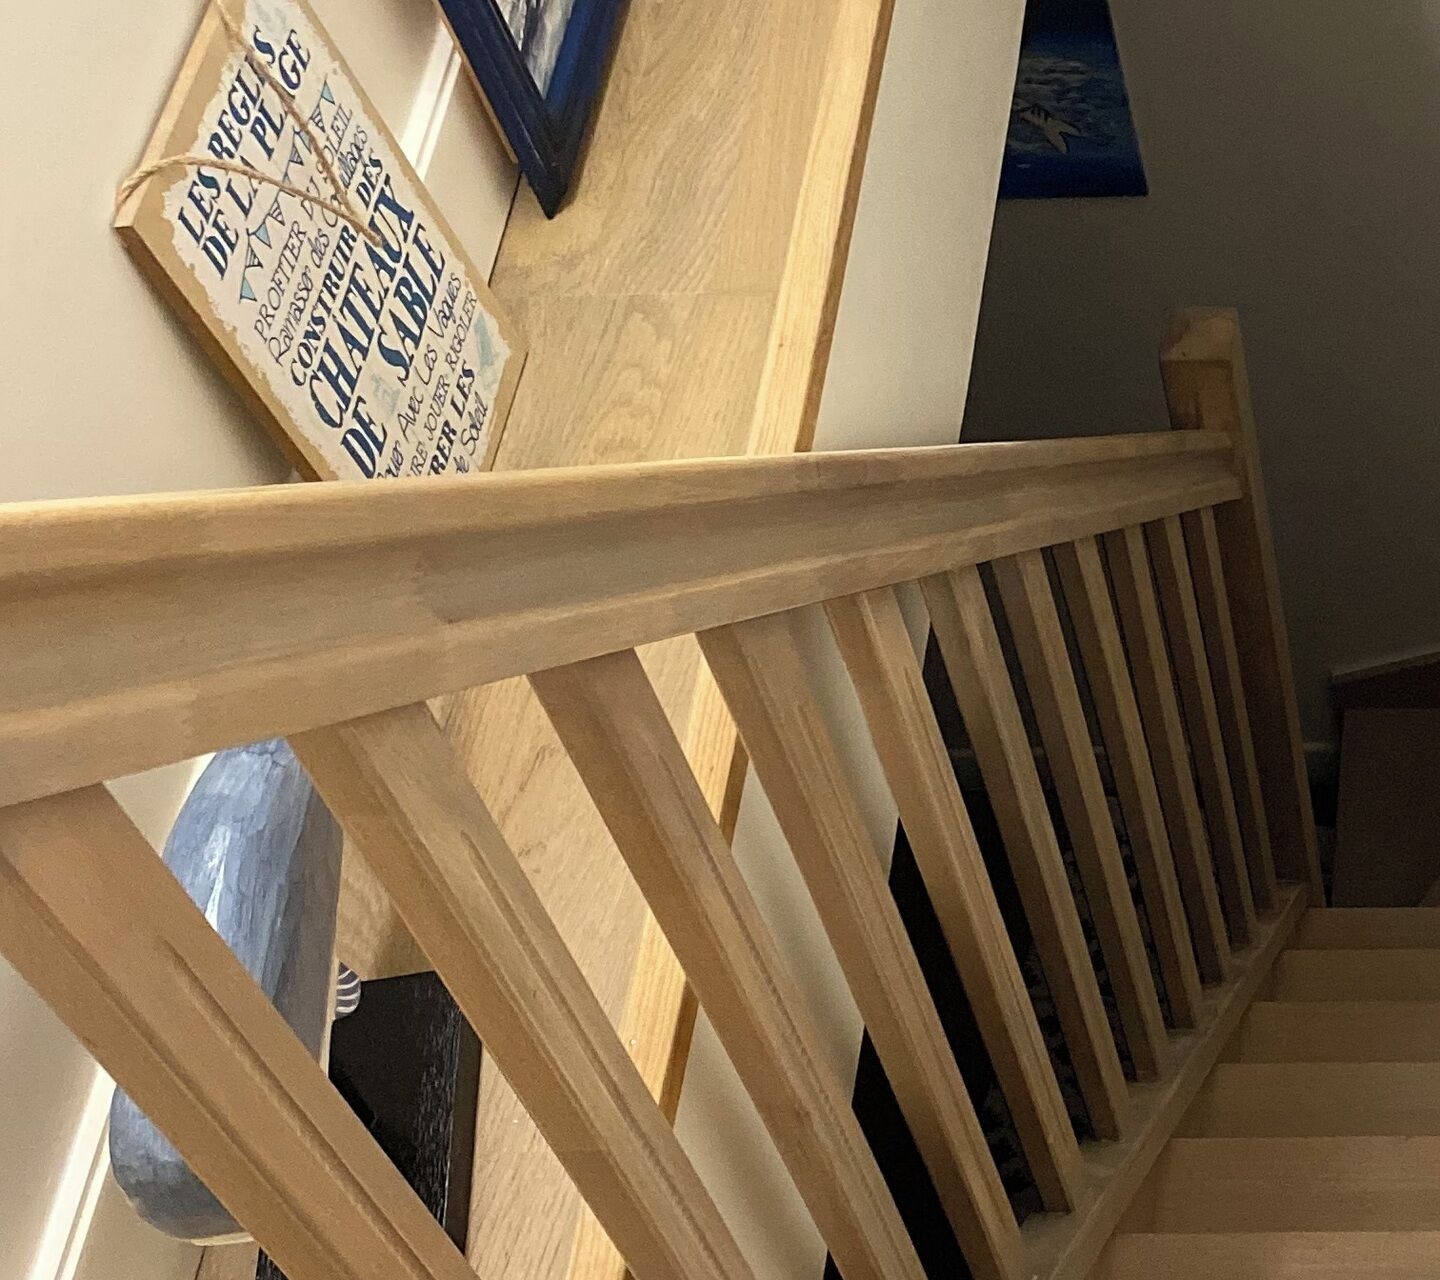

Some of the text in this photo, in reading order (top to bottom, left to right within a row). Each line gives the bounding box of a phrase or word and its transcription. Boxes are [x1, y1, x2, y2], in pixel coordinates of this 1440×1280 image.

[178, 167, 221, 245] LES
[202, 209, 239, 280] DE
[291, 148, 383, 387] CONSTRUIR DES
[254, 221, 306, 344] PROFITER
[268, 265, 314, 367] Ramasser
[308, 228, 331, 268] des
[340, 224, 446, 478] DE SABLE
[397, 387, 424, 442] Avec
[414, 344, 438, 385] Les
[427, 272, 461, 338] Vagues
[423, 375, 450, 441] JOUER
[445, 290, 477, 371] RIGOLER
[450, 360, 475, 418] LES
[461, 391, 488, 456] Soleil
